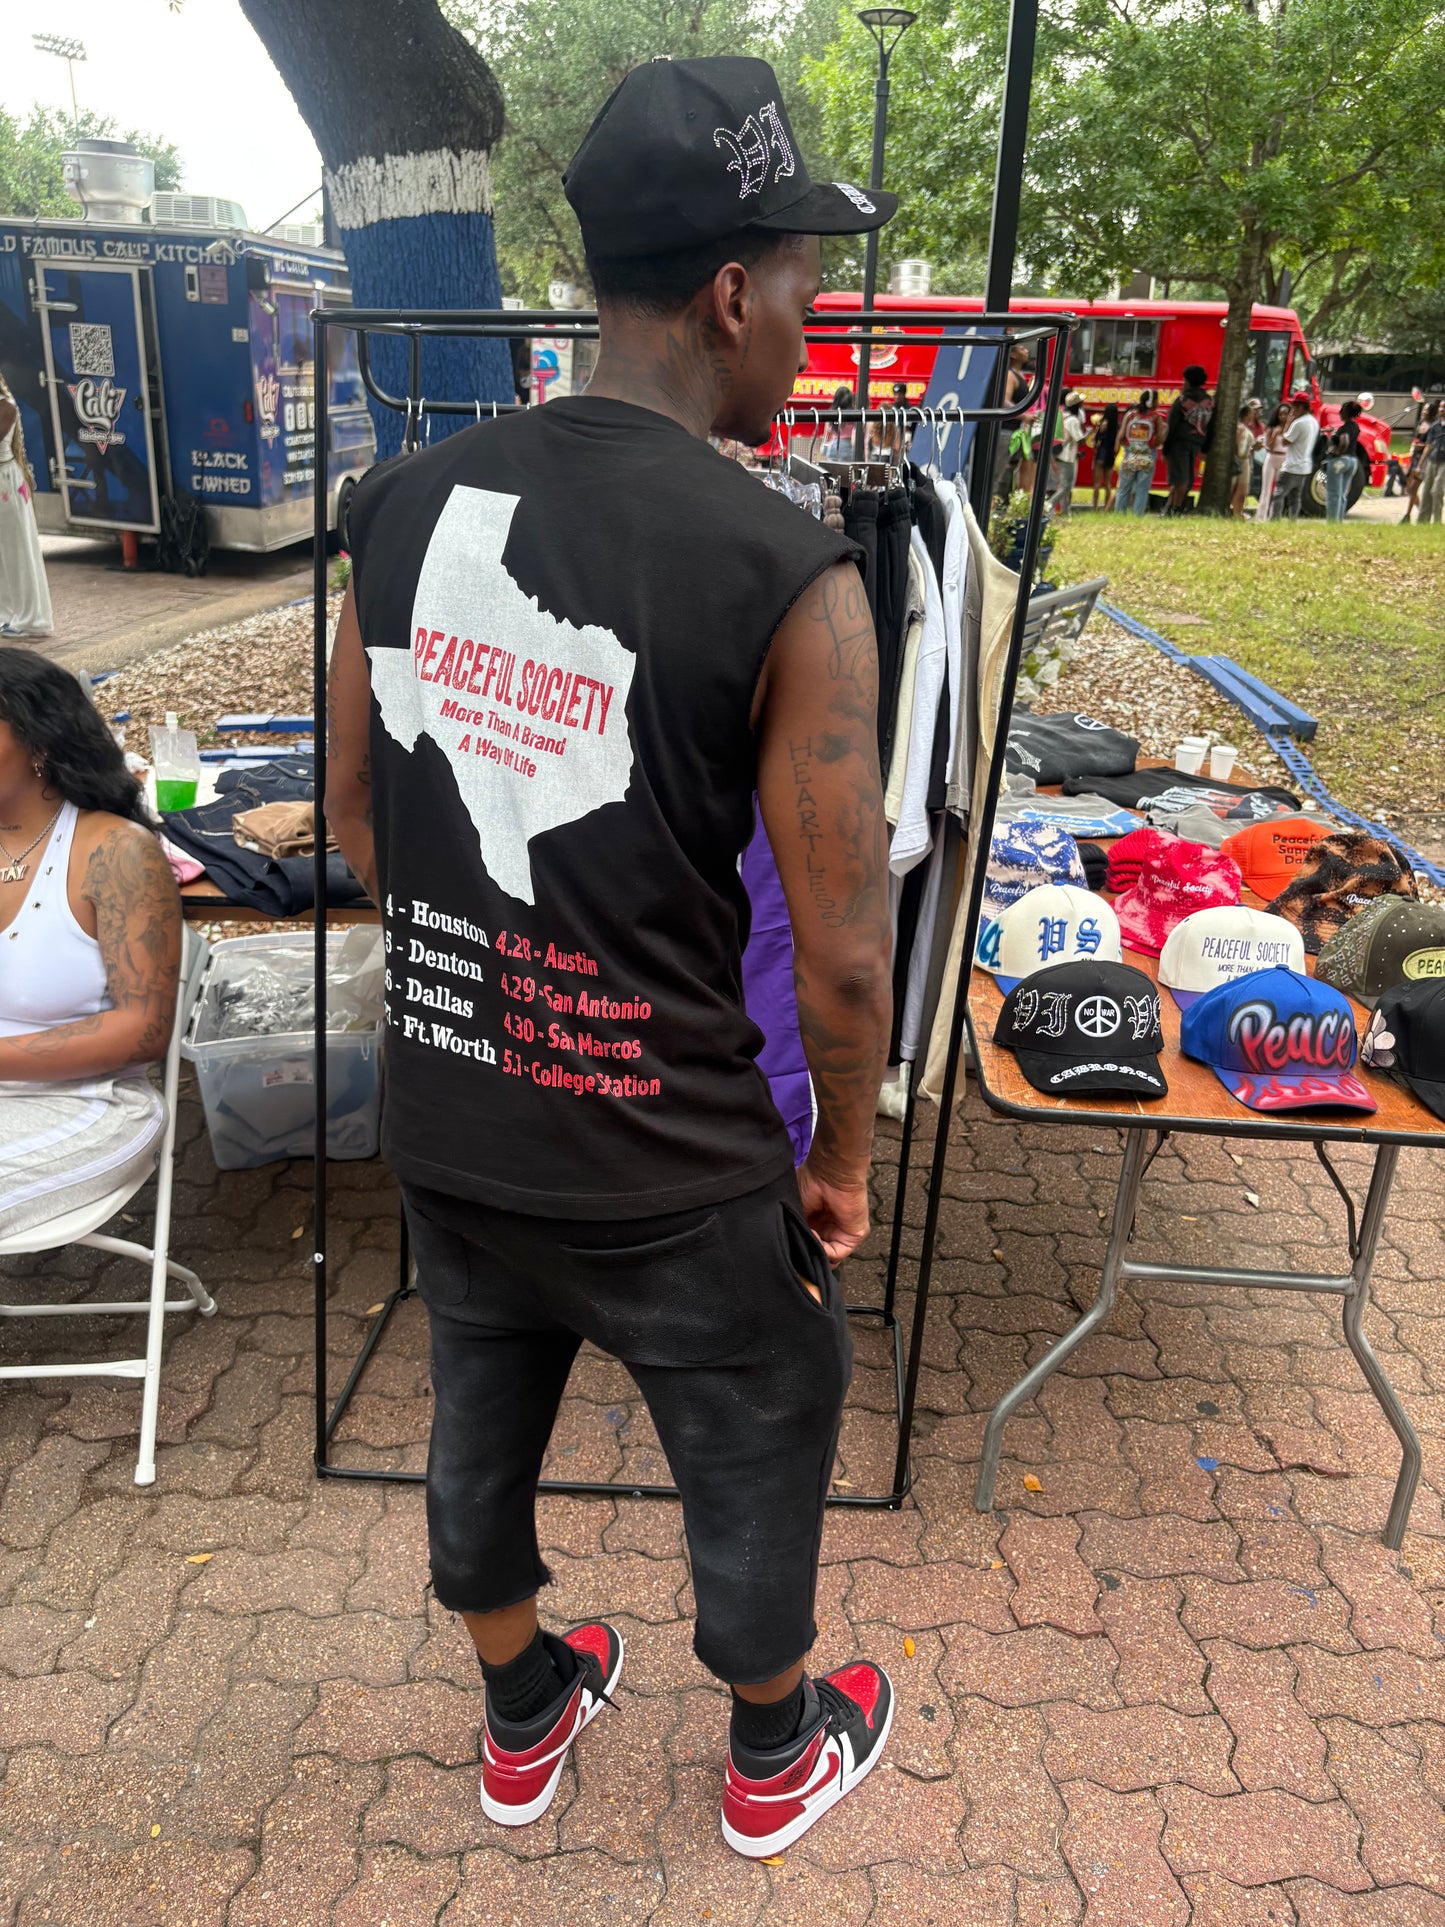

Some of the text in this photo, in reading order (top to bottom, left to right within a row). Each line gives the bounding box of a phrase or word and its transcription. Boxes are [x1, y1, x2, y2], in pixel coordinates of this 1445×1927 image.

[21, 236, 96, 257] FAMOUS
[75, 378, 117, 431] Cali
[793, 378, 854, 396] ATFISH
[414, 627, 615, 735] PEACEFUL SOCIETY
[439, 698, 567, 756] More Than A Brand
[457, 734, 537, 778] A Way Of Life
[788, 736, 846, 929] HEARTLESS
[1272, 834, 1317, 845] Peacef
[1278, 845, 1309, 856] Supp
[1284, 855, 1303, 865] Da
[411, 900, 490, 949] Houston
[408, 938, 484, 982] Denton
[495, 930, 532, 961] 4.28
[543, 943, 599, 977] Austin
[1201, 937, 1291, 963] PEACEFUL SOCIETY
[1218, 964, 1235, 973] MORE
[1417, 960, 1445, 975] PEA
[405, 977, 474, 1019] Dallas
[501, 972, 536, 1003] 4.29
[575, 991, 652, 1020] Antonio
[1083, 1008, 1115, 1017] NO WAR
[503, 1012, 535, 1043] 4.30
[577, 1032, 642, 1060] Marcos
[1227, 999, 1351, 1075] Peace
[502, 1049, 522, 1077] 5.1
[531, 1061, 595, 1096] College
[596, 1072, 661, 1098] Station
